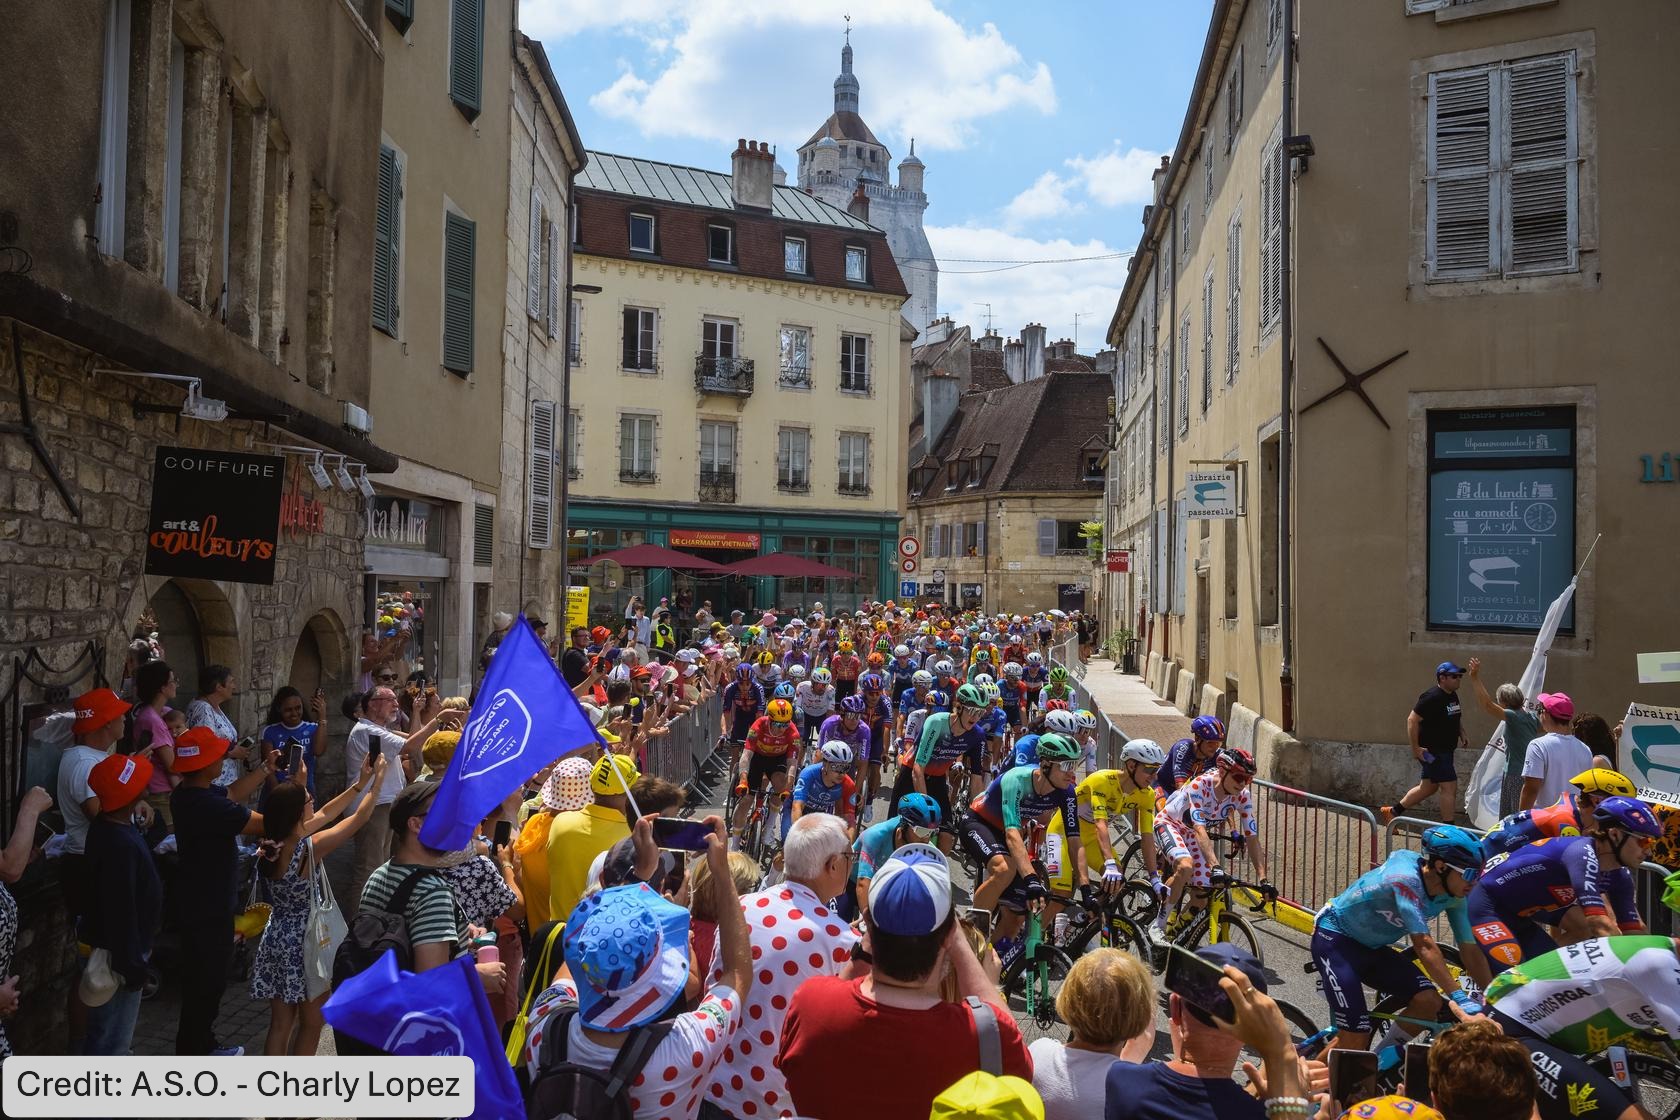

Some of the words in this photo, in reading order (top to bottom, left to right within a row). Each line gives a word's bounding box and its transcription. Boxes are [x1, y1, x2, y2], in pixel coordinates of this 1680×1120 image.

[164, 456, 275, 478] COIFFURE
[1473, 482, 1490, 498] du
[1495, 482, 1528, 498] lundi
[1187, 507, 1234, 518] passerelle
[1453, 510, 1469, 518] au
[1475, 501, 1519, 518] samedi
[681, 539, 720, 547] CHARMANT
[1504, 869, 1521, 883] HANS
[1521, 864, 1547, 876] ANDERS
[1001, 945, 1020, 966] YSEL
[1520, 995, 1559, 1025] SEGUROS
[1554, 986, 1592, 1007] RGA
[1530, 1051, 1563, 1080] CAJA
